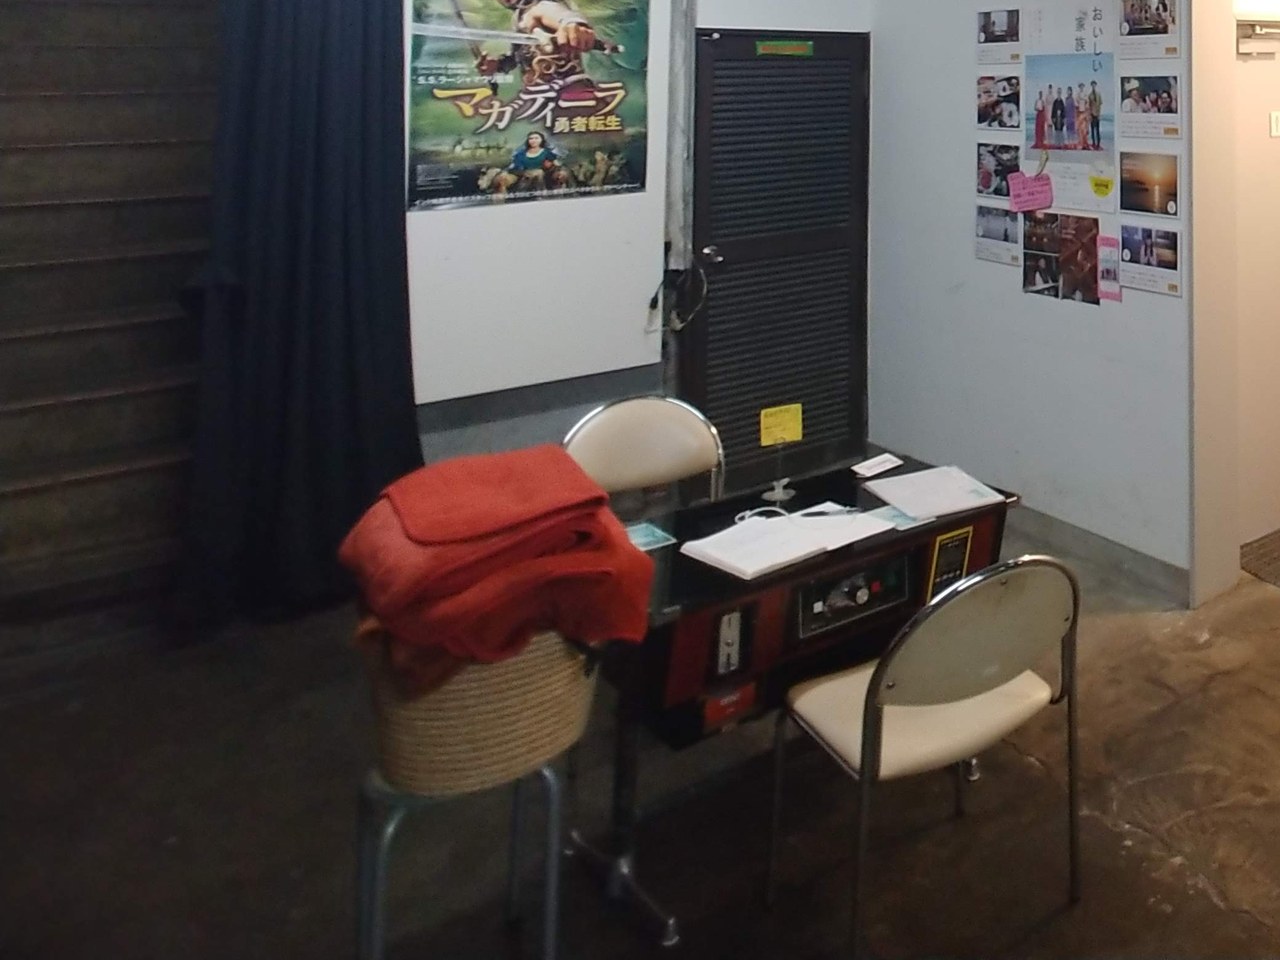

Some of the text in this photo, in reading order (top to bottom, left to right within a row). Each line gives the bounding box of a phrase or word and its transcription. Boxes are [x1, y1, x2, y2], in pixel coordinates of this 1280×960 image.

[1092, 6, 1103, 72] おいしい
[432, 81, 626, 134] マガディーラ
[552, 116, 623, 134] 勇者転生
